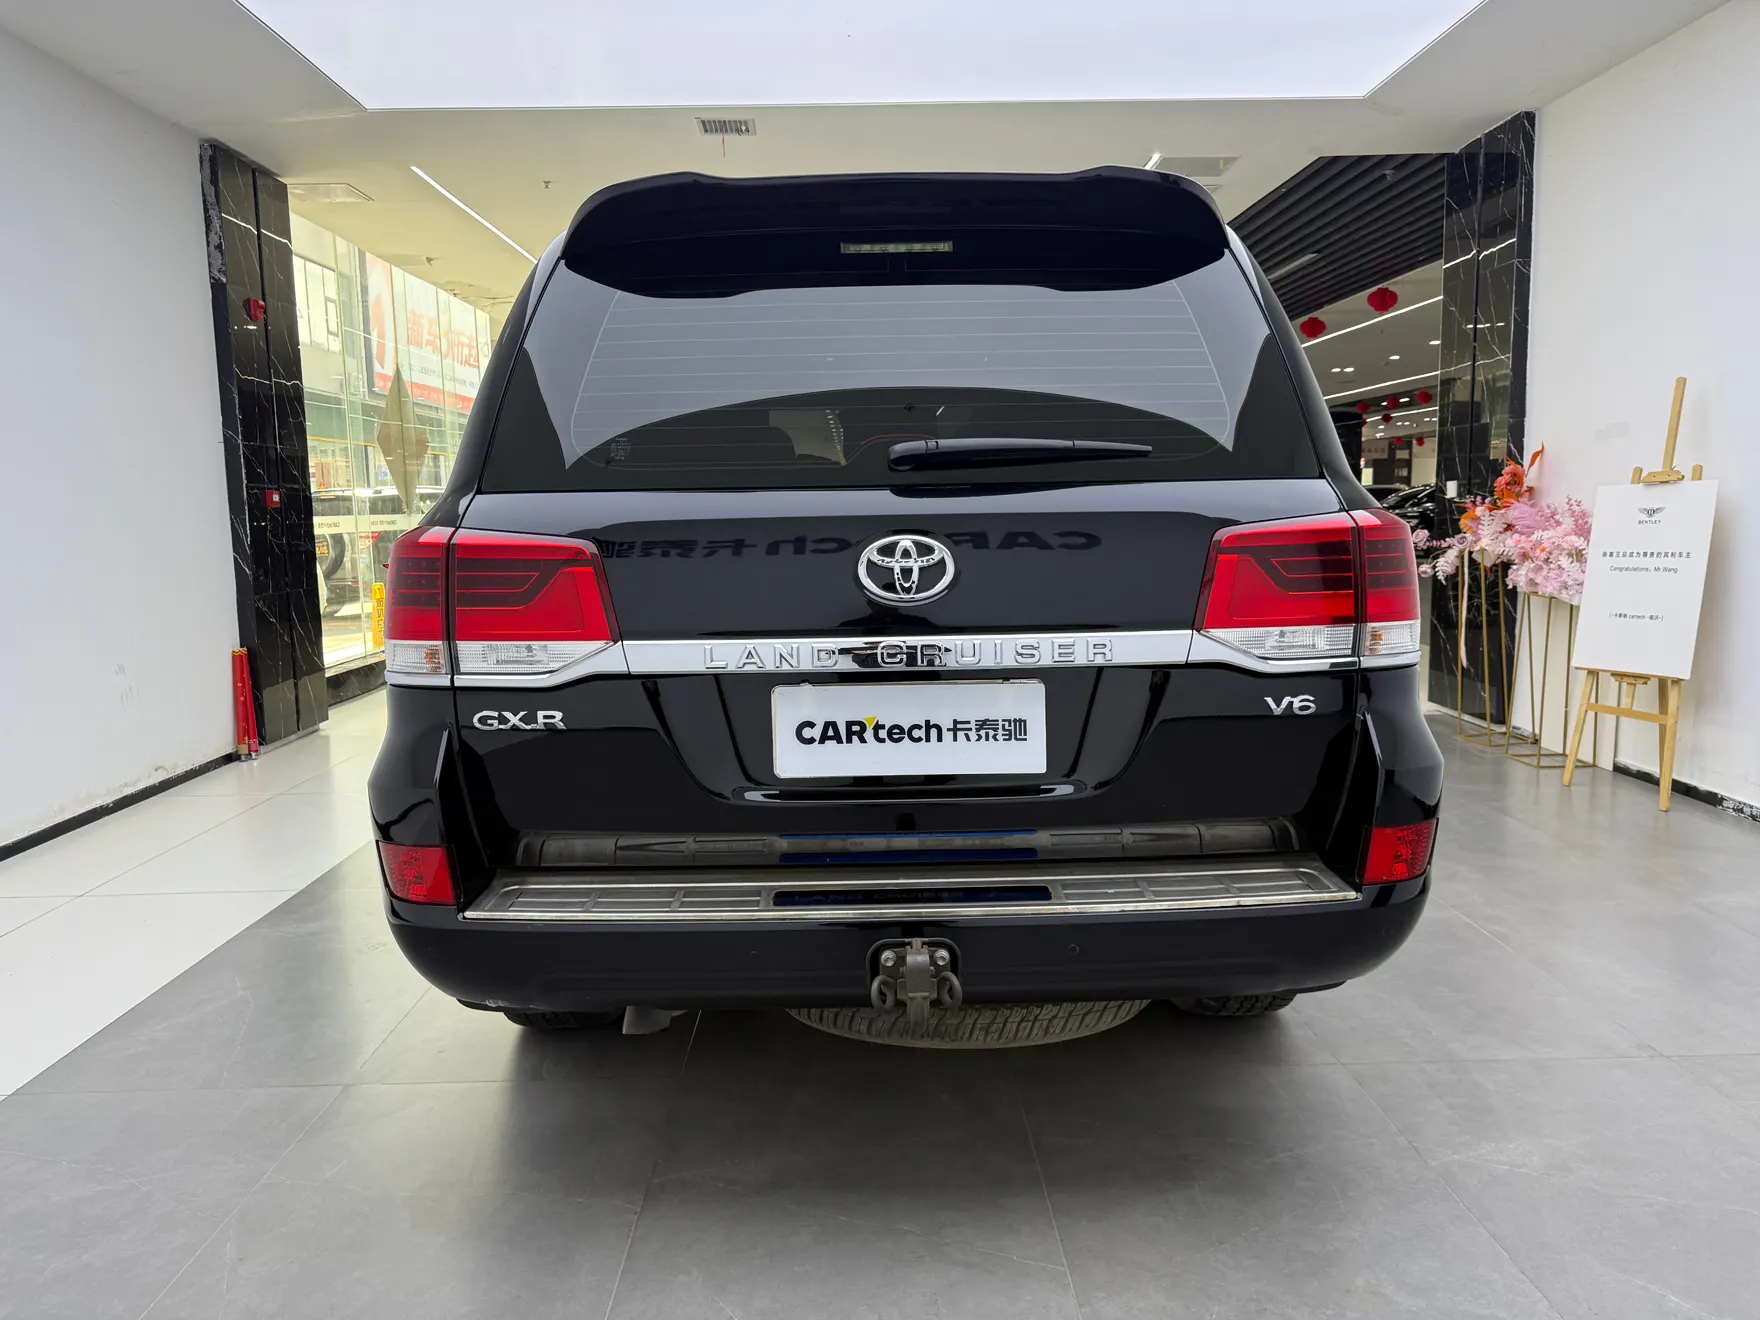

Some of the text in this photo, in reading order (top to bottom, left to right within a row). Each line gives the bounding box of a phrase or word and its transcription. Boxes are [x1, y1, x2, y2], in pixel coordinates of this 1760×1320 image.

[703, 636, 1114, 669] LAND CRUISER
[1263, 694, 1317, 716] V6
[946, 717, 1028, 742] 卡泰驰
[794, 893, 864, 902] LAND
